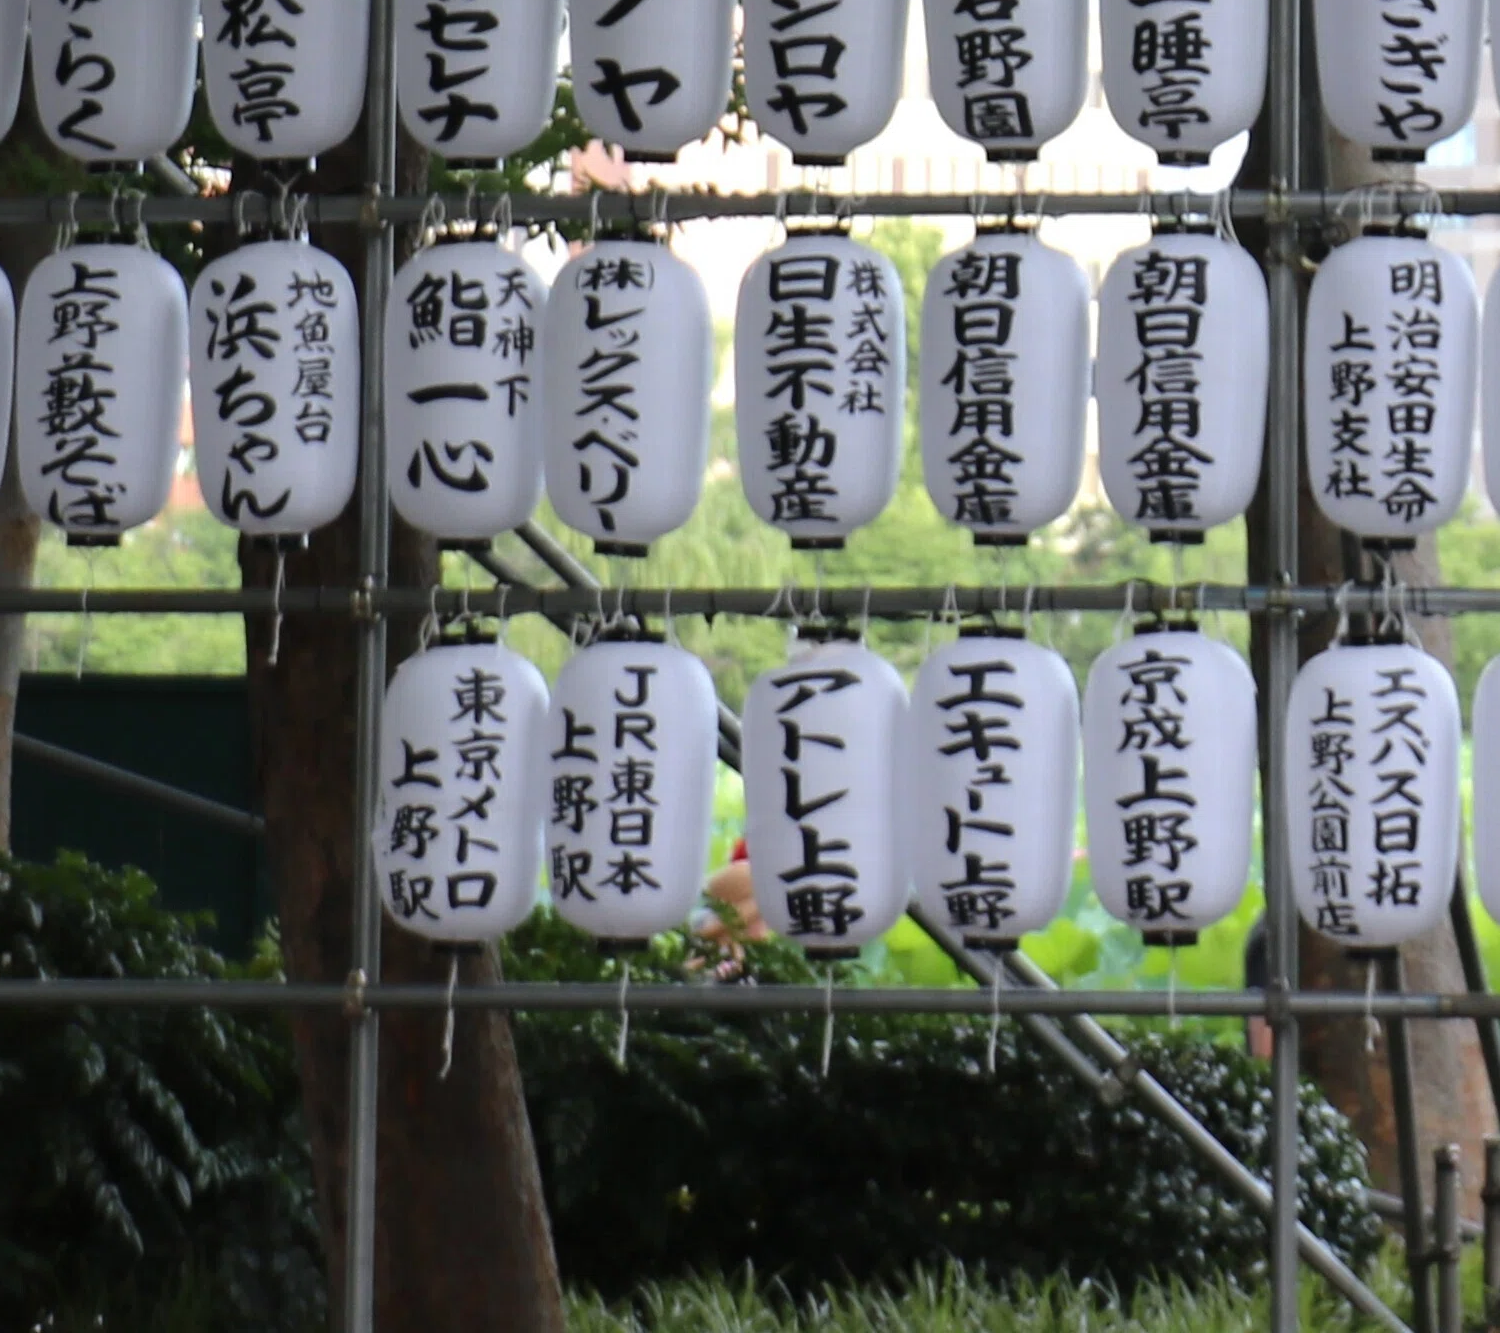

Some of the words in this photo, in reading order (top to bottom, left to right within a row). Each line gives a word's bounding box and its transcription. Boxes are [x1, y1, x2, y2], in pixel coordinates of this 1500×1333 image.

[205, 273, 291, 522] 浜ちゃん
[287, 272, 337, 445] 地魚屋台
[405, 270, 494, 494] 鮨一心
[492, 268, 535, 418] 天神下
[764, 255, 842, 524] 日生不動産
[839, 258, 891, 415] 株式会社
[940, 250, 1024, 527] 朝日信用金庫
[1124, 250, 1215, 522] 朝日信用金庫
[1324, 311, 1377, 500] 上野支社
[1378, 260, 1443, 524] 明治安田生命
[388, 738, 443, 922] 上野駅
[446, 668, 506, 911] 東京メトロ
[550, 707, 599, 903] 上野駅
[599, 666, 661, 896] JR東日本
[769, 670, 865, 939] アトレ上野
[936, 660, 1025, 929] エキュート上野
[1115, 650, 1198, 924] 京成上野駅
[1308, 688, 1362, 933] 上野公園前店
